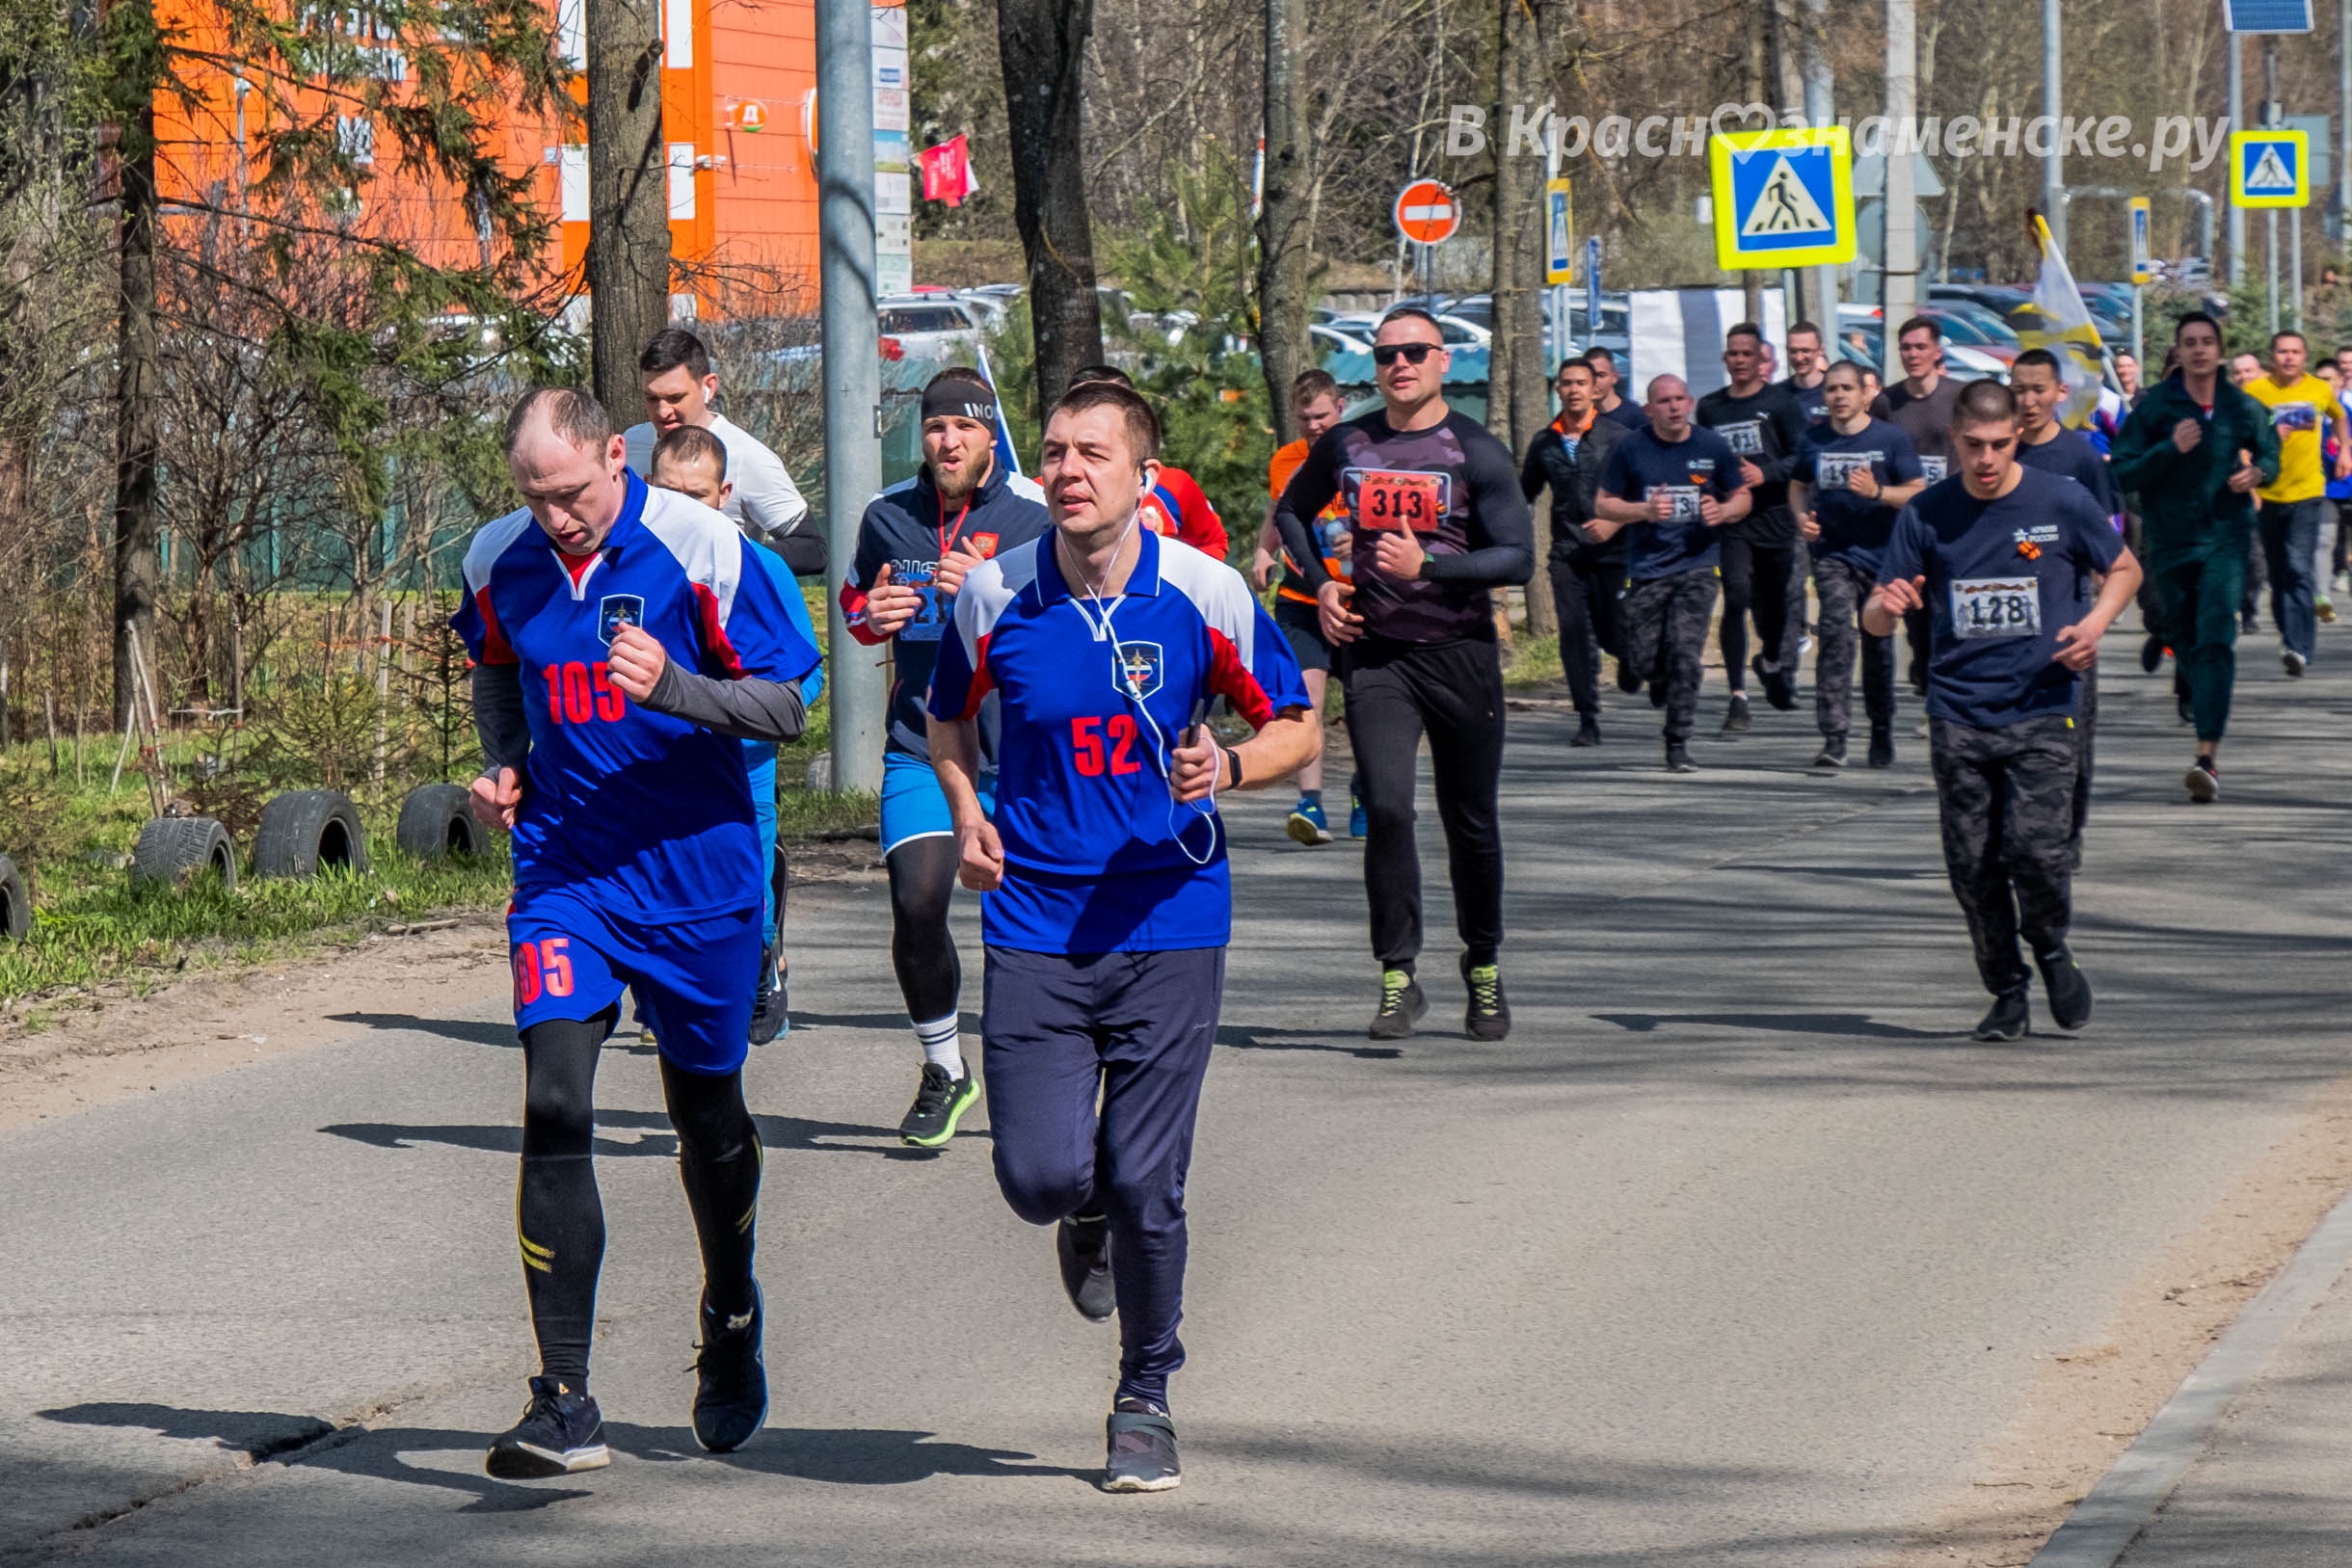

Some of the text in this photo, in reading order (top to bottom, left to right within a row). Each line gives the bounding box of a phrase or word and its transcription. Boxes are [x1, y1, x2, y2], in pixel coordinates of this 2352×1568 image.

[1372, 489, 1423, 518] 313
[1970, 596, 2025, 625] 128
[543, 660, 626, 725] 105
[1071, 714, 1141, 777] 52
